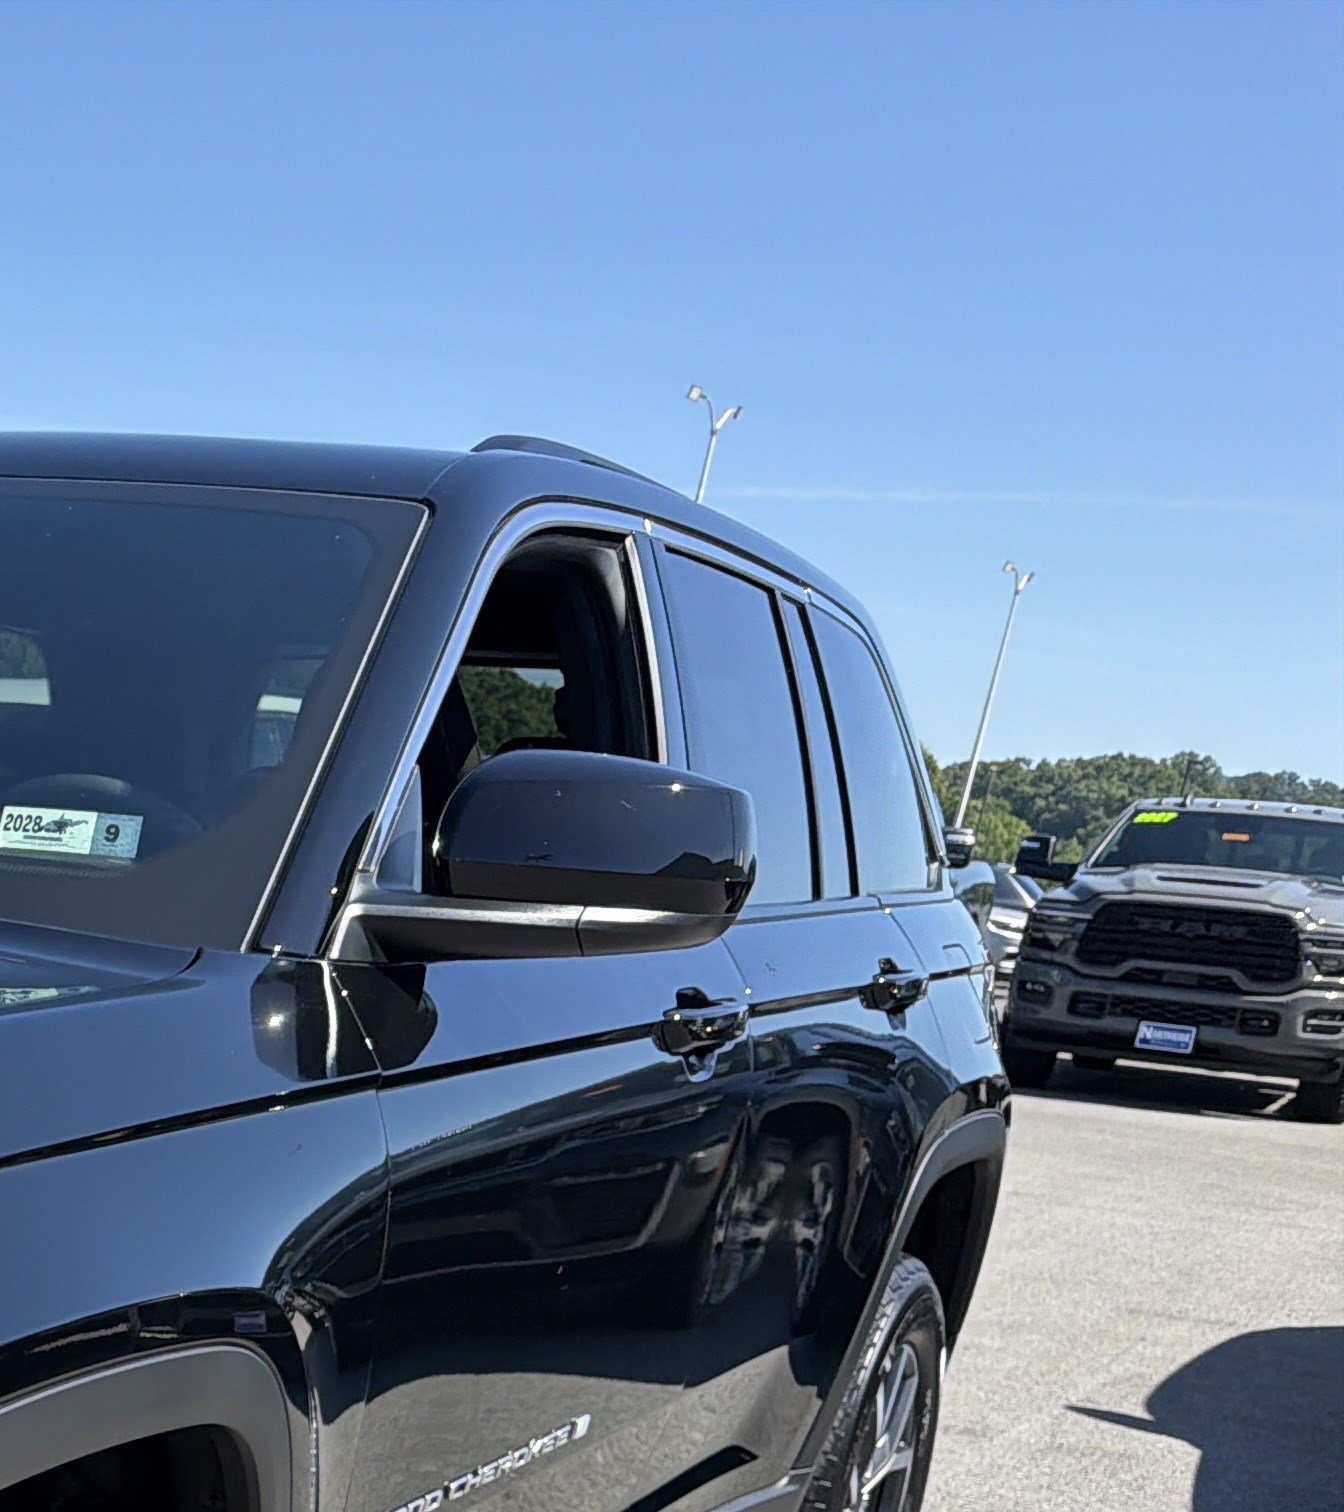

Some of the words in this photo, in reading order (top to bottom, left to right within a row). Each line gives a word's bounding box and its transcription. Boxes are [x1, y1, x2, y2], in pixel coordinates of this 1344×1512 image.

[3, 813, 45, 833] 2028
[104, 823, 121, 843] 9
[449, 1424, 572, 1500] CHEROKEE
